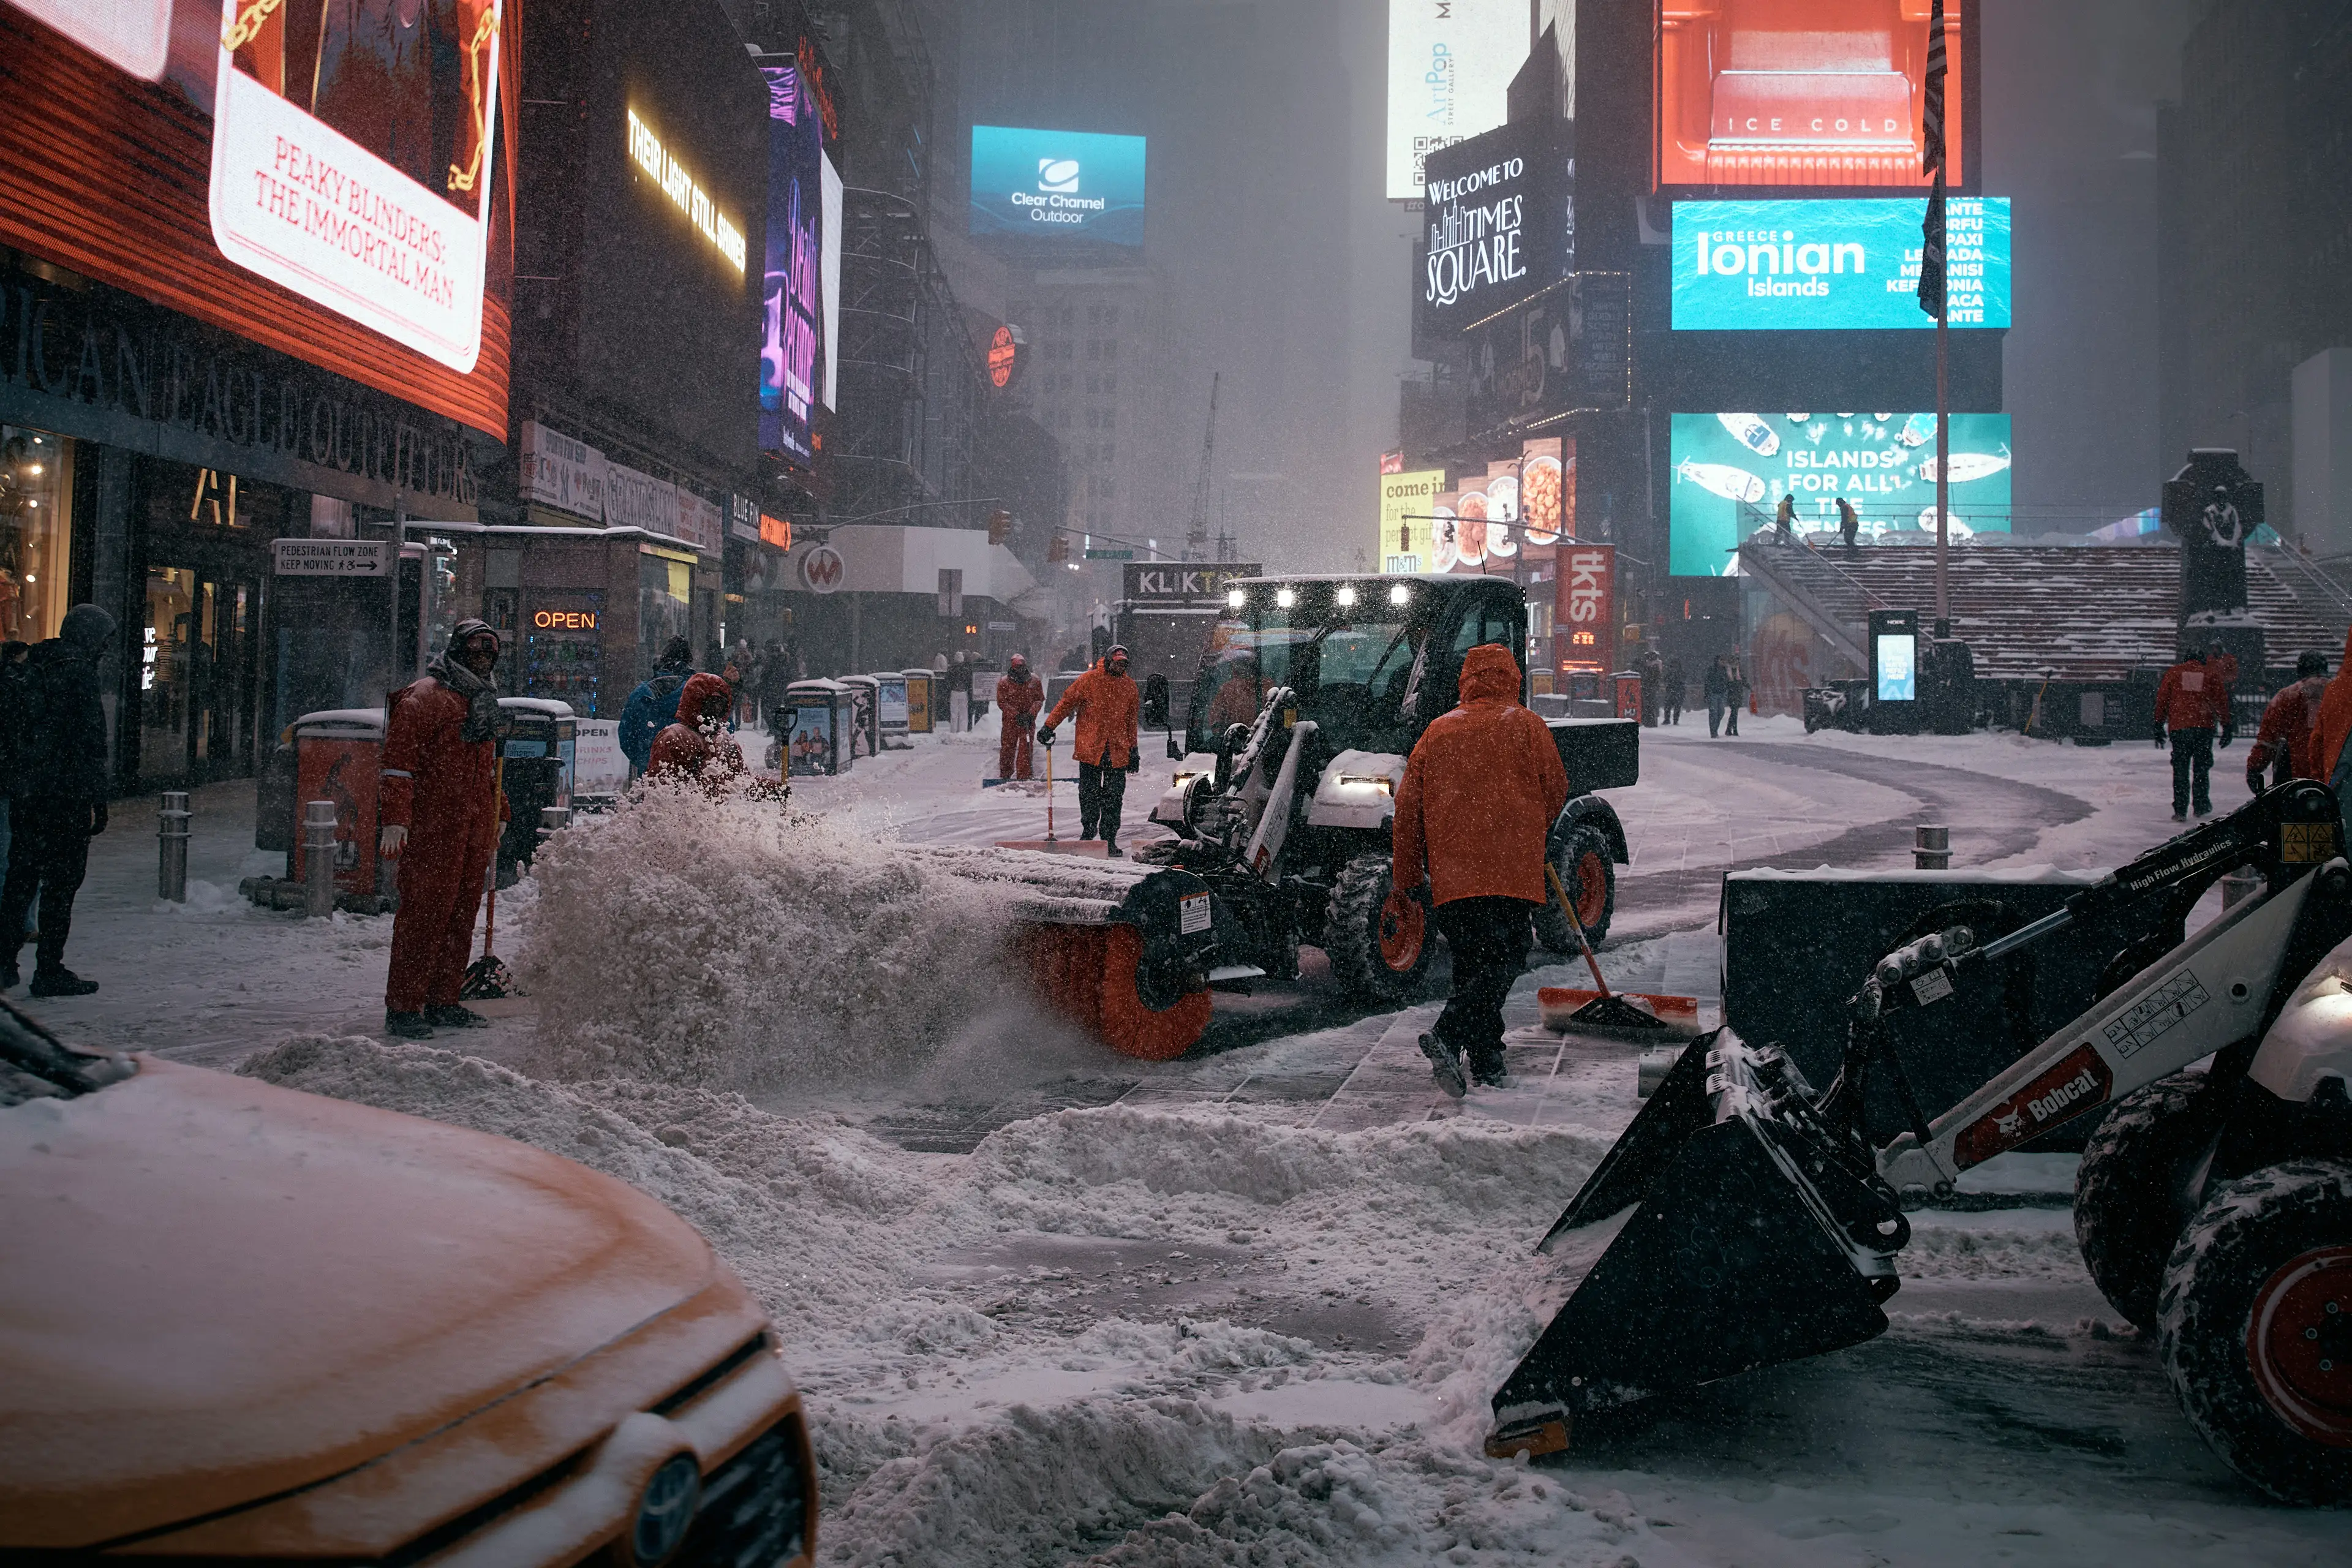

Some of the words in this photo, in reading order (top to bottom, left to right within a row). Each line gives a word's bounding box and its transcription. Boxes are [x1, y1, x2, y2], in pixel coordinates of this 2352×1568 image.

[1425, 42, 1452, 125] ArtPop
[1728, 118, 1782, 132] ICE
[1811, 118, 1897, 132] COLD
[628, 108, 661, 184] THEIR
[662, 149, 693, 215] LIGHT
[691, 185, 717, 244] STILL
[717, 213, 746, 273] SHINES
[1428, 165, 1501, 206] WELCOME
[1502, 157, 1524, 179] TO
[274, 135, 344, 206] PEAKY
[348, 183, 447, 266] BLINDERS:
[1011, 192, 1047, 206] Clear
[1049, 194, 1105, 210] Channel
[1031, 208, 1084, 224] Outdoor
[1466, 194, 1523, 241] TIMES
[254, 170, 301, 227] THE
[304, 198, 412, 286] IMMORTAL
[413, 258, 455, 310] MAN
[1713, 230, 1777, 242] GREECE
[1697, 230, 1866, 275] Ionian
[1904, 248, 1984, 262] LEADA
[1747, 276, 1830, 297] Islands
[162, 341, 301, 452] EAGLE
[311, 393, 481, 506] OUTFITTERS
[1787, 450, 1894, 469] ISLANDS
[1386, 482, 1429, 499] come
[1789, 473, 1838, 492] FOR
[1845, 473, 1893, 492] ALL
[733, 492, 748, 522] BLUE
[749, 501, 760, 526] FIN
[1385, 503, 1399, 521] for
[1401, 502, 1416, 519] the
[281, 545, 331, 557] PEDESTRIAN
[333, 546, 355, 557] FLOW
[357, 546, 379, 557] ZONE
[281, 559, 302, 570] KEEP
[303, 559, 334, 570] MOVING
[1569, 551, 1605, 622] tkts
[534, 611, 595, 629] OPEN
[2130, 873, 2155, 891] High
[2154, 864, 2179, 880] Flow
[2180, 839, 2233, 868] Hydraulics
[2027, 1067, 2100, 1123] Bobcat
